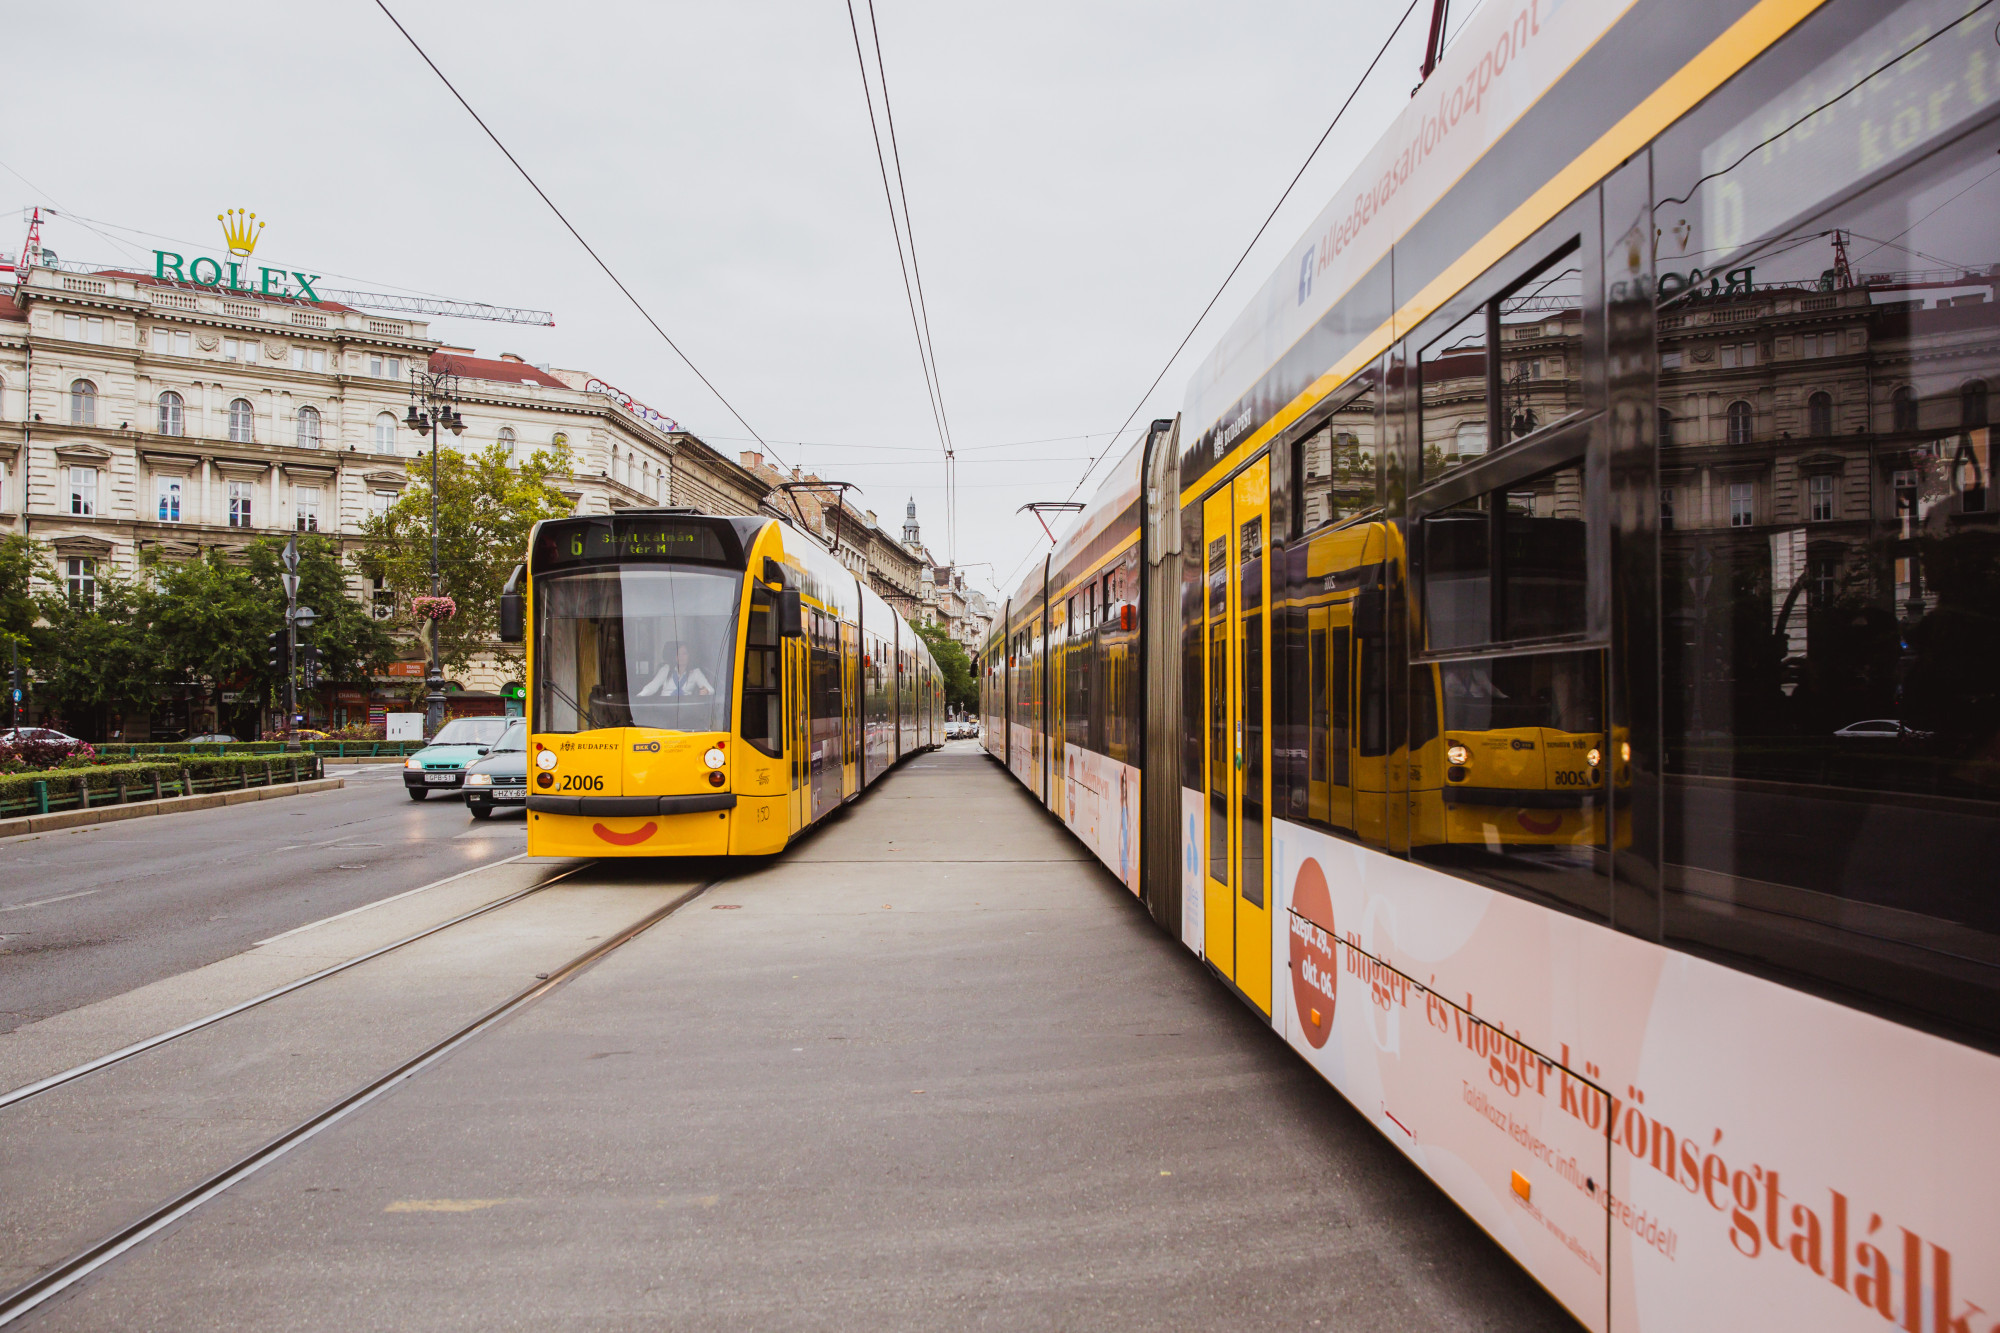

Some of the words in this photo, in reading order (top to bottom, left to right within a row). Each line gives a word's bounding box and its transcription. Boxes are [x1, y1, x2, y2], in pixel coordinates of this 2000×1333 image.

[1859, 50, 2000, 171] kört
[1317, 0, 1540, 277] AlleeBevasarlokozpont
[152, 249, 324, 303] ROLEX
[571, 533, 583, 556] 6
[498, 789, 527, 798] HZY-69
[562, 774, 604, 791] 2006
[1302, 954, 1320, 990] okt.
[1320, 970, 1335, 1001] 06.
[1426, 974, 1448, 1034] és
[1452, 992, 1552, 1098] vlogger
[1559, 1042, 2000, 1333] közönségtalálk
[1508, 1112, 1554, 1169] kedvenc
